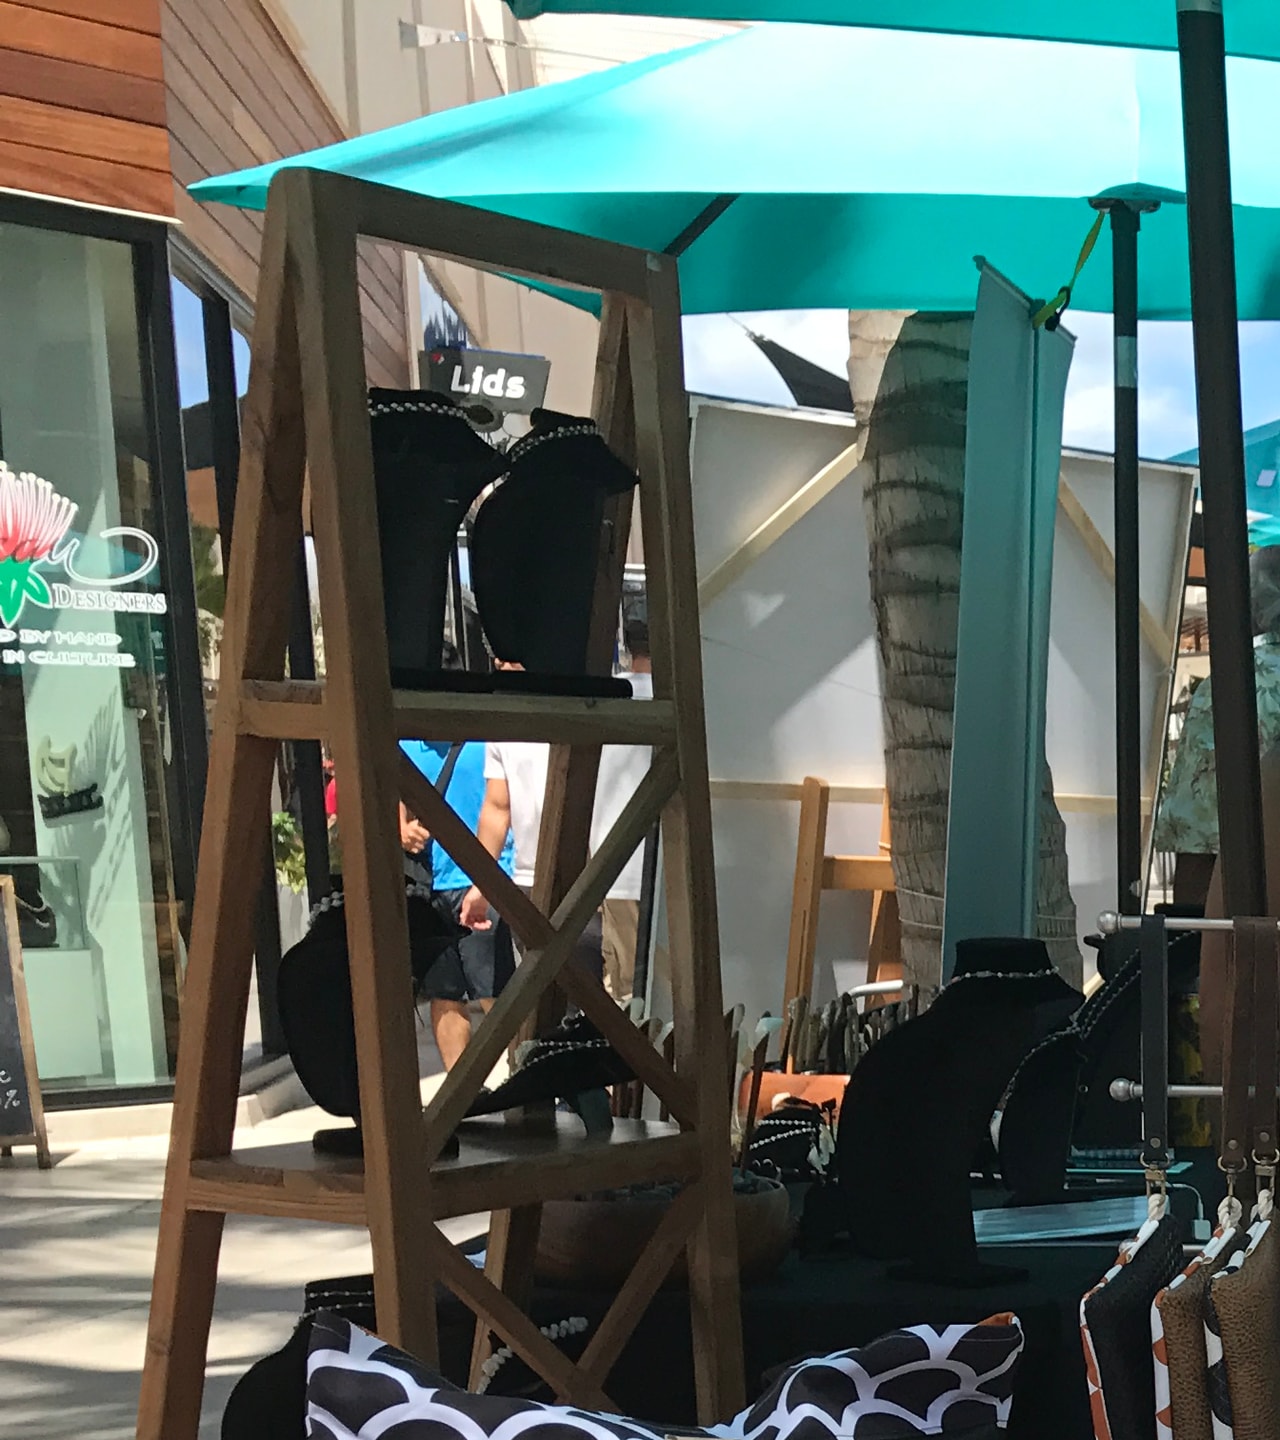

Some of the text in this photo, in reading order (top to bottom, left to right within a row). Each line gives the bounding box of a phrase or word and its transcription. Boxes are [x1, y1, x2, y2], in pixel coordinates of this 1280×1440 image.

[451, 365, 525, 399] Lids
[53, 584, 166, 613] DESIGNERS
[20, 630, 50, 645] BY
[55, 632, 122, 648] HAND
[29, 651, 136, 668] CULTURE
